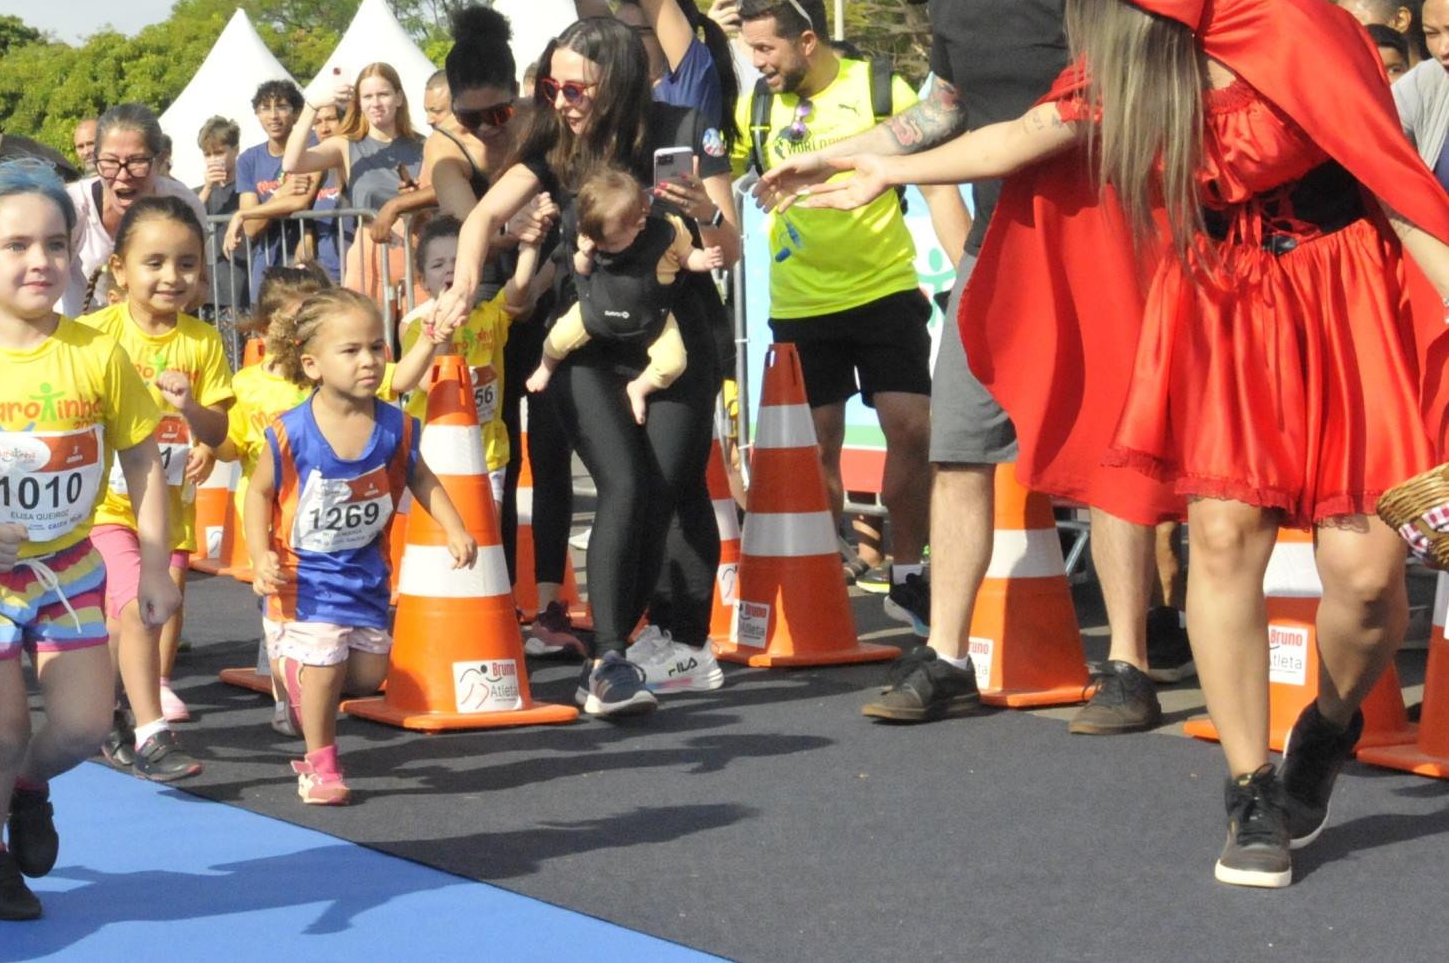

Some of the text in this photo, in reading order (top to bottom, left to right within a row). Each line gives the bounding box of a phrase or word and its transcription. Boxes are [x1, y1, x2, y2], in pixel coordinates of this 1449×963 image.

[10, 510, 34, 520] ELISA
[36, 509, 70, 520] QUEIROZ
[309, 502, 380, 531] 1269
[1270, 629, 1304, 647] Bruno
[969, 641, 989, 655] runo
[1270, 653, 1303, 670] tleta
[492, 662, 515, 677] Bruno
[491, 684, 519, 698] Atleta
